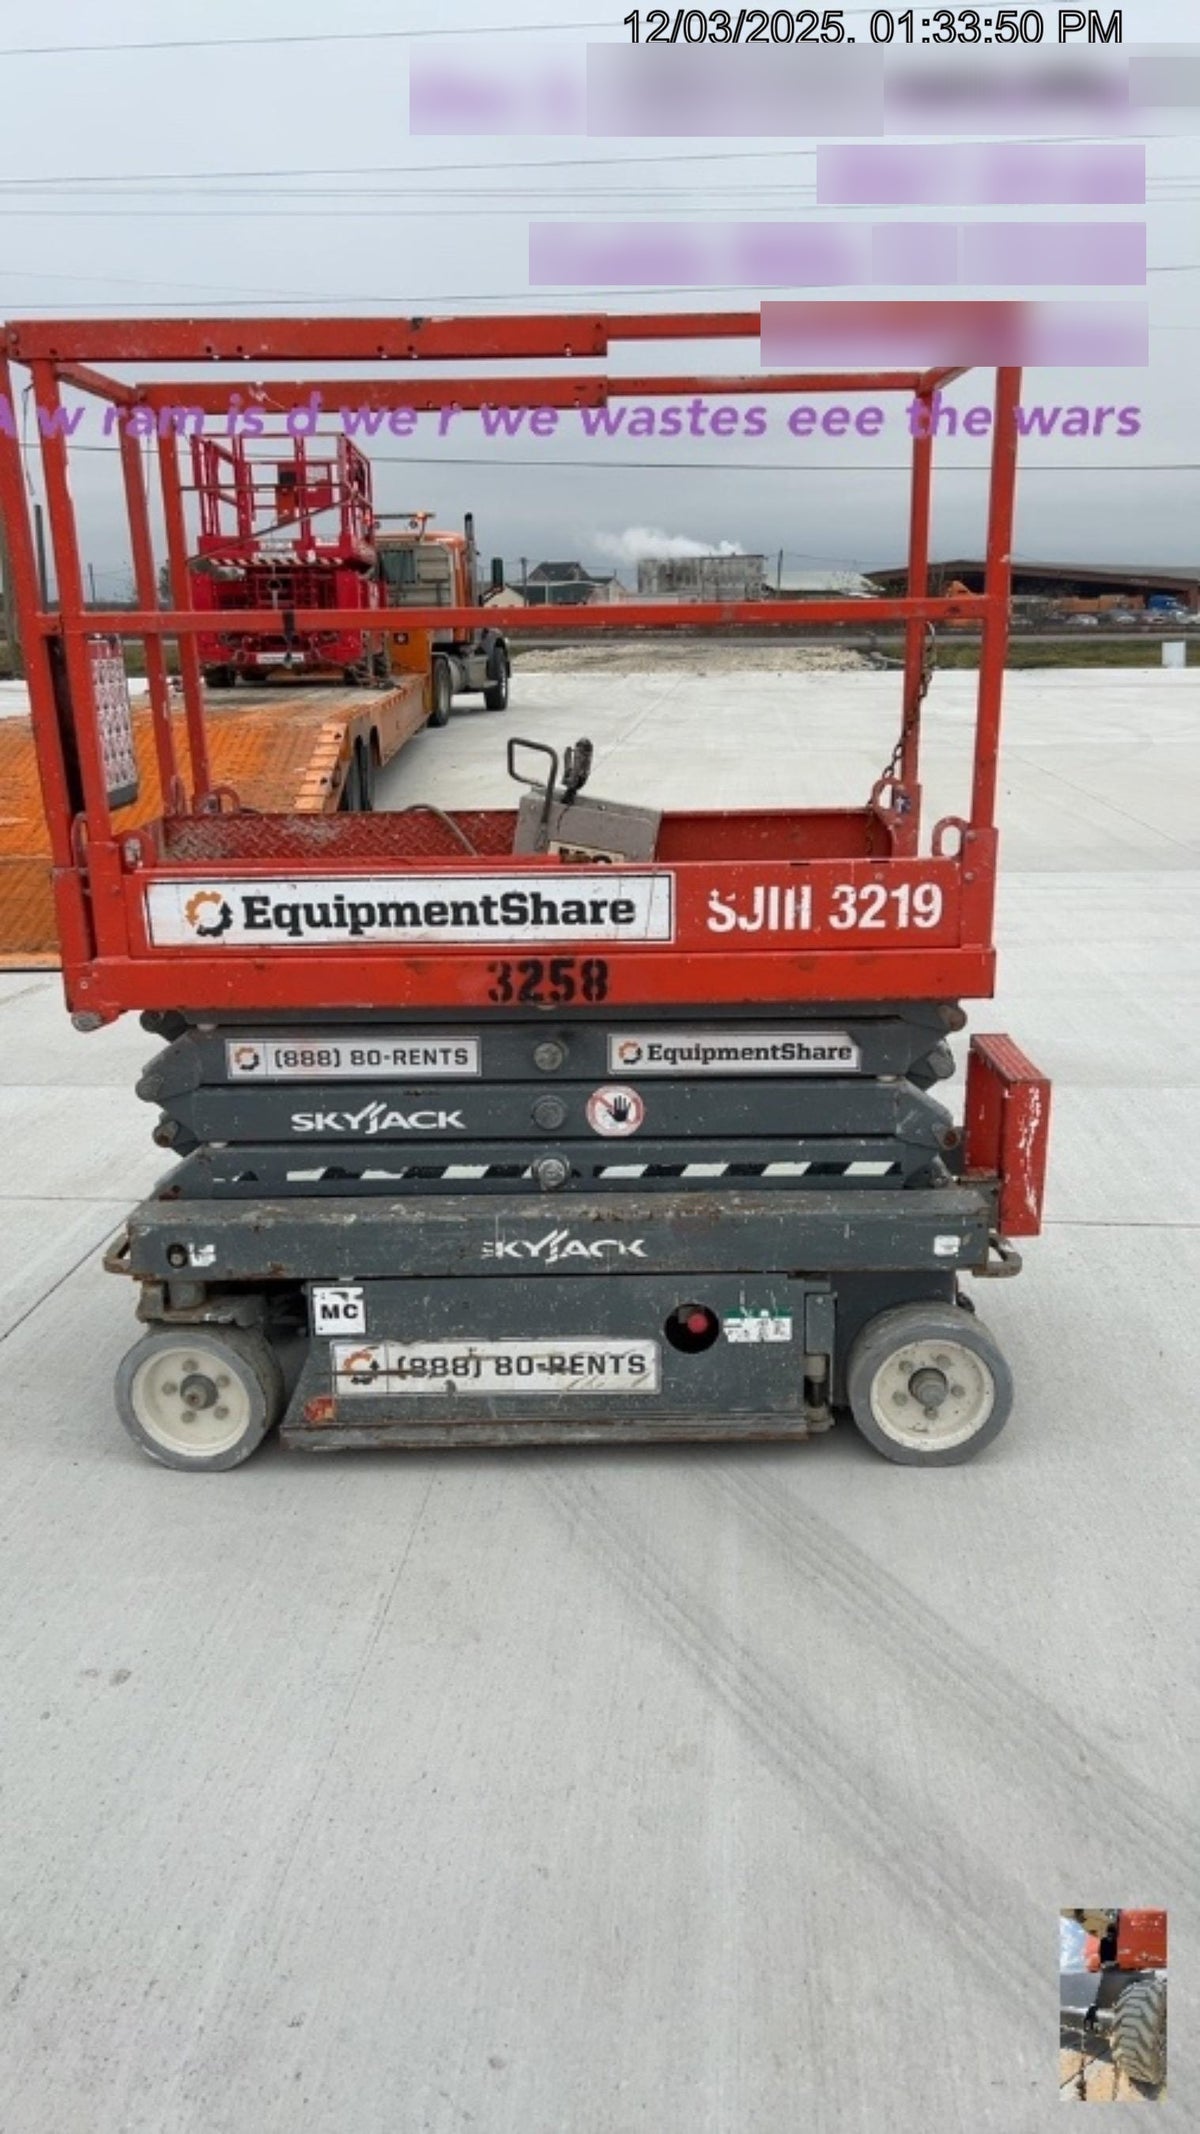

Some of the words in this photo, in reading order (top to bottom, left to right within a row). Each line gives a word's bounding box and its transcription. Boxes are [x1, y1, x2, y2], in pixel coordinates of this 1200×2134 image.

[241, 892, 636, 937] EquipmentShare
[828, 882, 942, 930] 3219
[487, 958, 609, 1003] 3258
[274, 1048, 341, 1068] (888)
[350, 1047, 468, 1066] 80-RENTS
[647, 1042, 853, 1065] EquipmentShare
[291, 1100, 467, 1135] SKYJACK
[321, 1303, 358, 1319] MC
[398, 1355, 481, 1379] (888)
[495, 1354, 646, 1377] 80-RENTS
